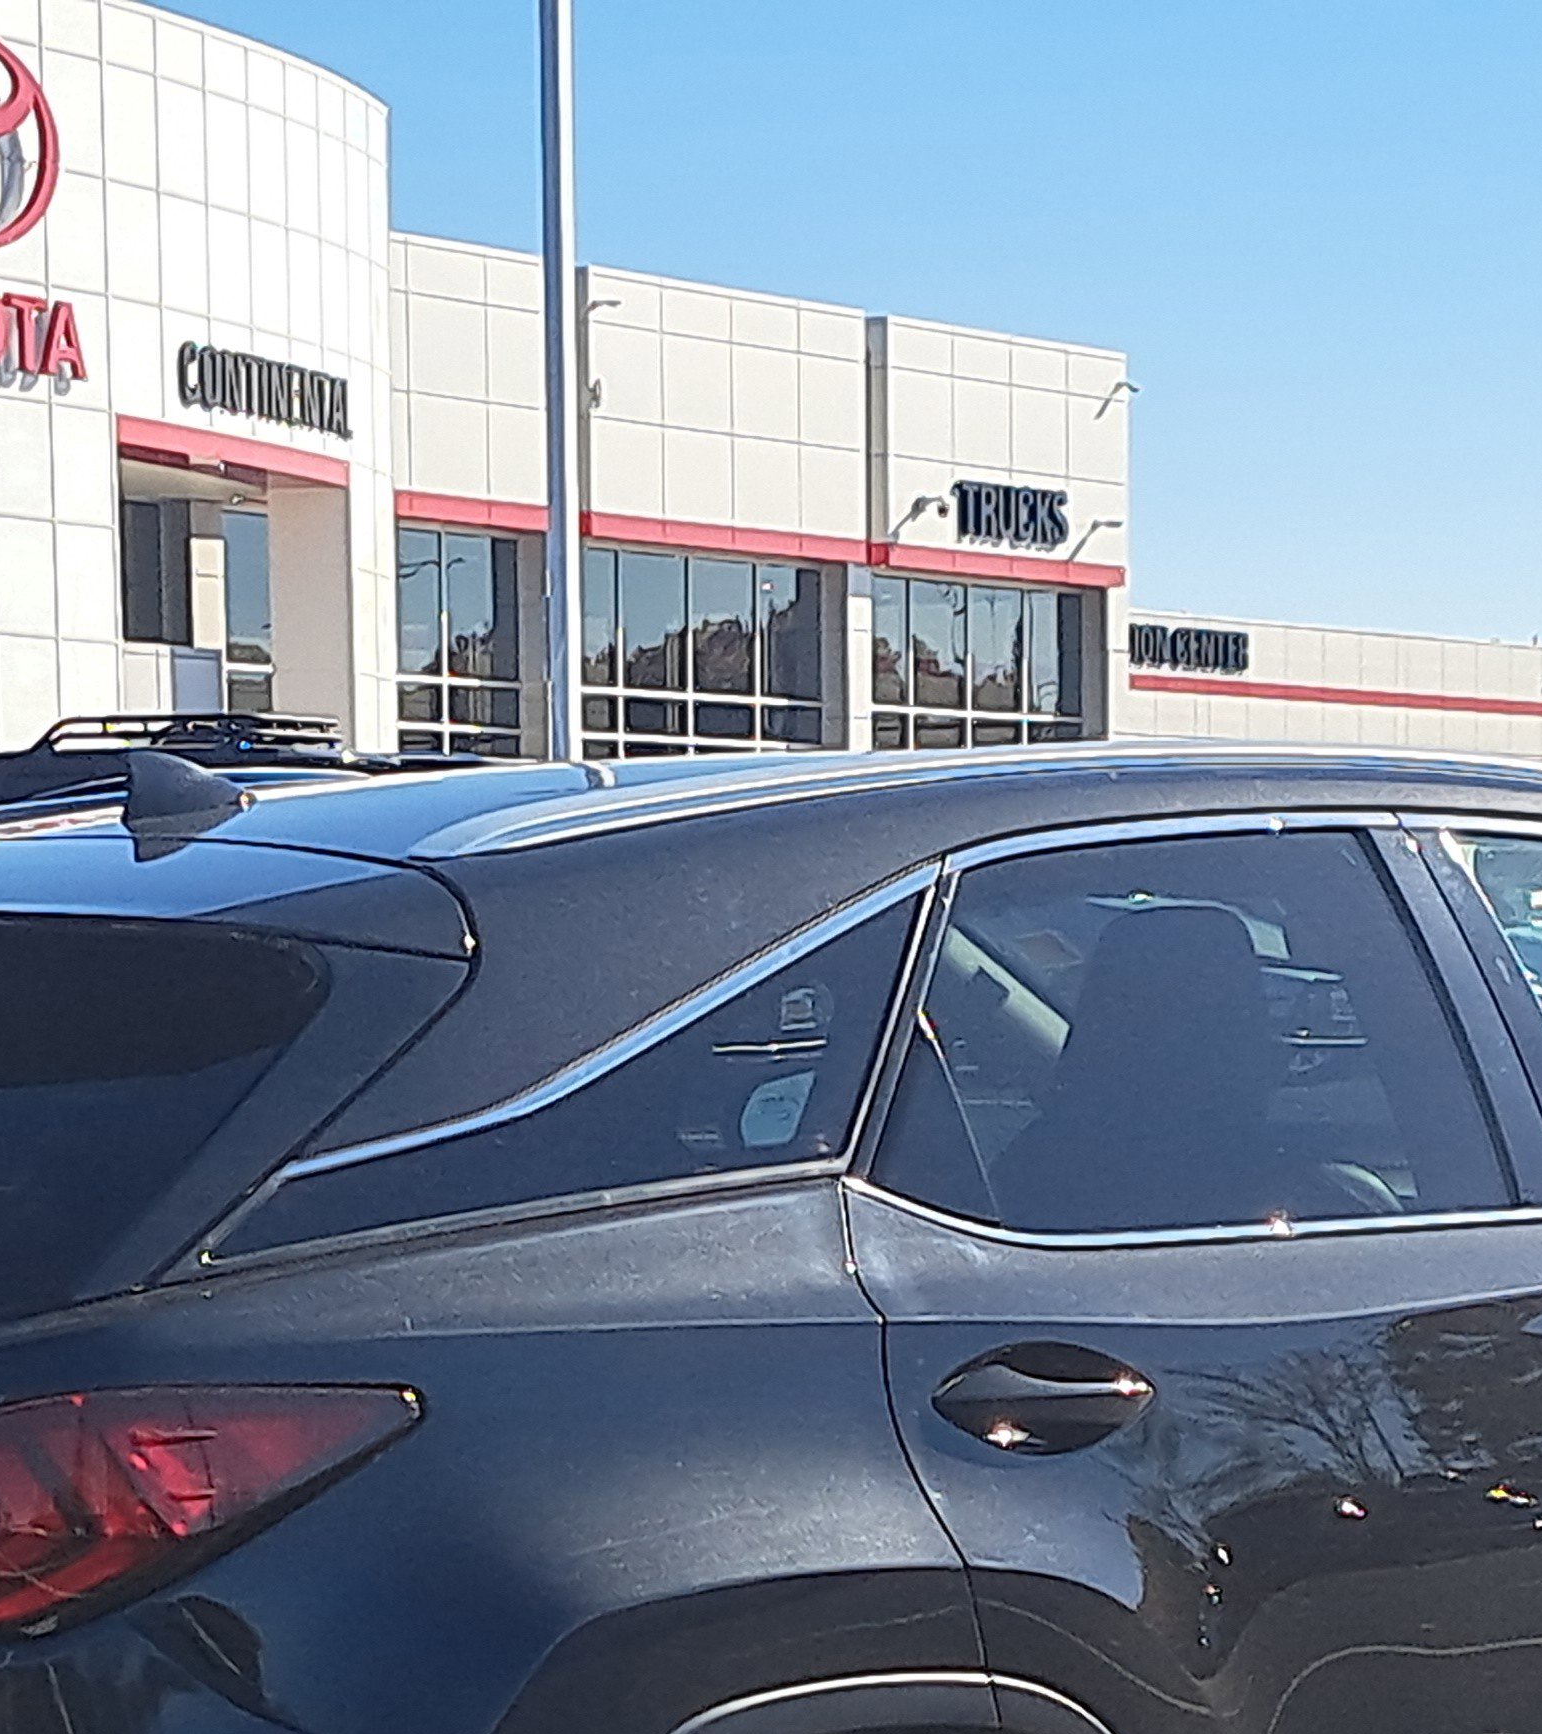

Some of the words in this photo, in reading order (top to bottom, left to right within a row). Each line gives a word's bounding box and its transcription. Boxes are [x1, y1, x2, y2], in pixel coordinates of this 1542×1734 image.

[177, 340, 354, 441] CONTINENTAL
[952, 480, 1070, 546] TRUCKS
[1170, 626, 1249, 674] CENTER
